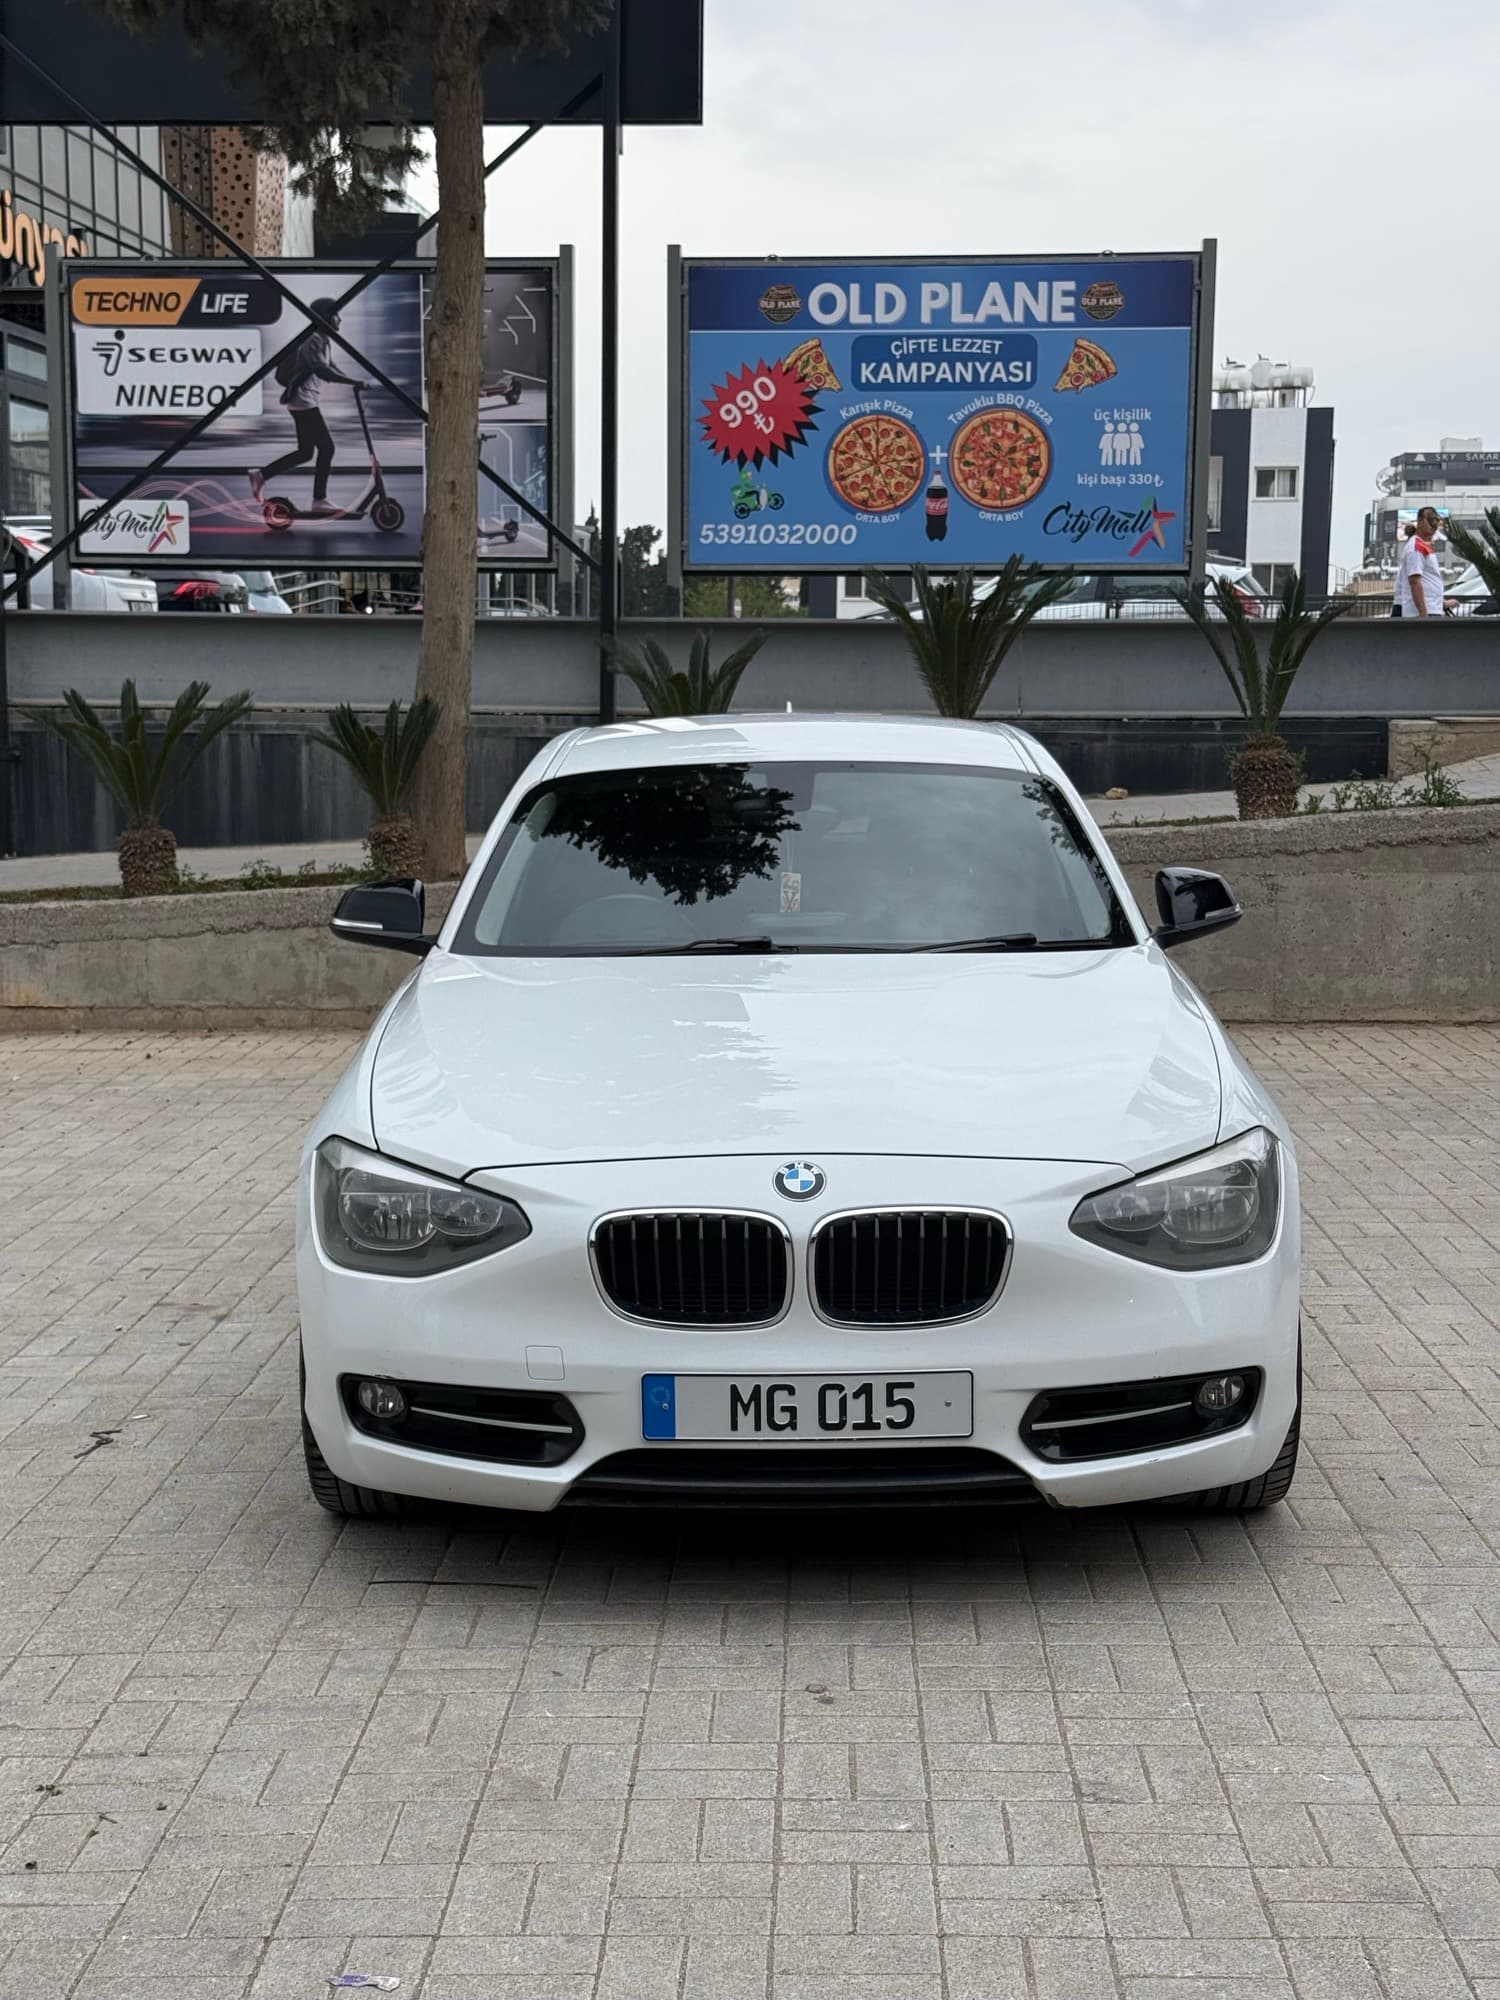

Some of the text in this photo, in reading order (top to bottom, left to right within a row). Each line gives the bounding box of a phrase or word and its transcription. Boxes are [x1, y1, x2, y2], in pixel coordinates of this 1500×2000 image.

[84, 291, 249, 314] TECHNO LIFE
[807, 281, 1076, 325] OLD PLANE
[128, 347, 253, 363] SEGWAY
[890, 337, 1003, 359] ÇİFTE LEZZET
[860, 361, 1032, 384] KAMPANYASI
[720, 376, 776, 428] 990
[883, 400, 914, 420] Pizza
[947, 392, 1054, 425] Tavuklu BBQ Pizza
[1077, 474, 1097, 487] kişi
[856, 512, 901, 524] ORTA BOY
[978, 511, 1024, 522] ORTA BOY
[700, 524, 857, 544] 5391032000
[730, 1381, 915, 1432] MG 015
